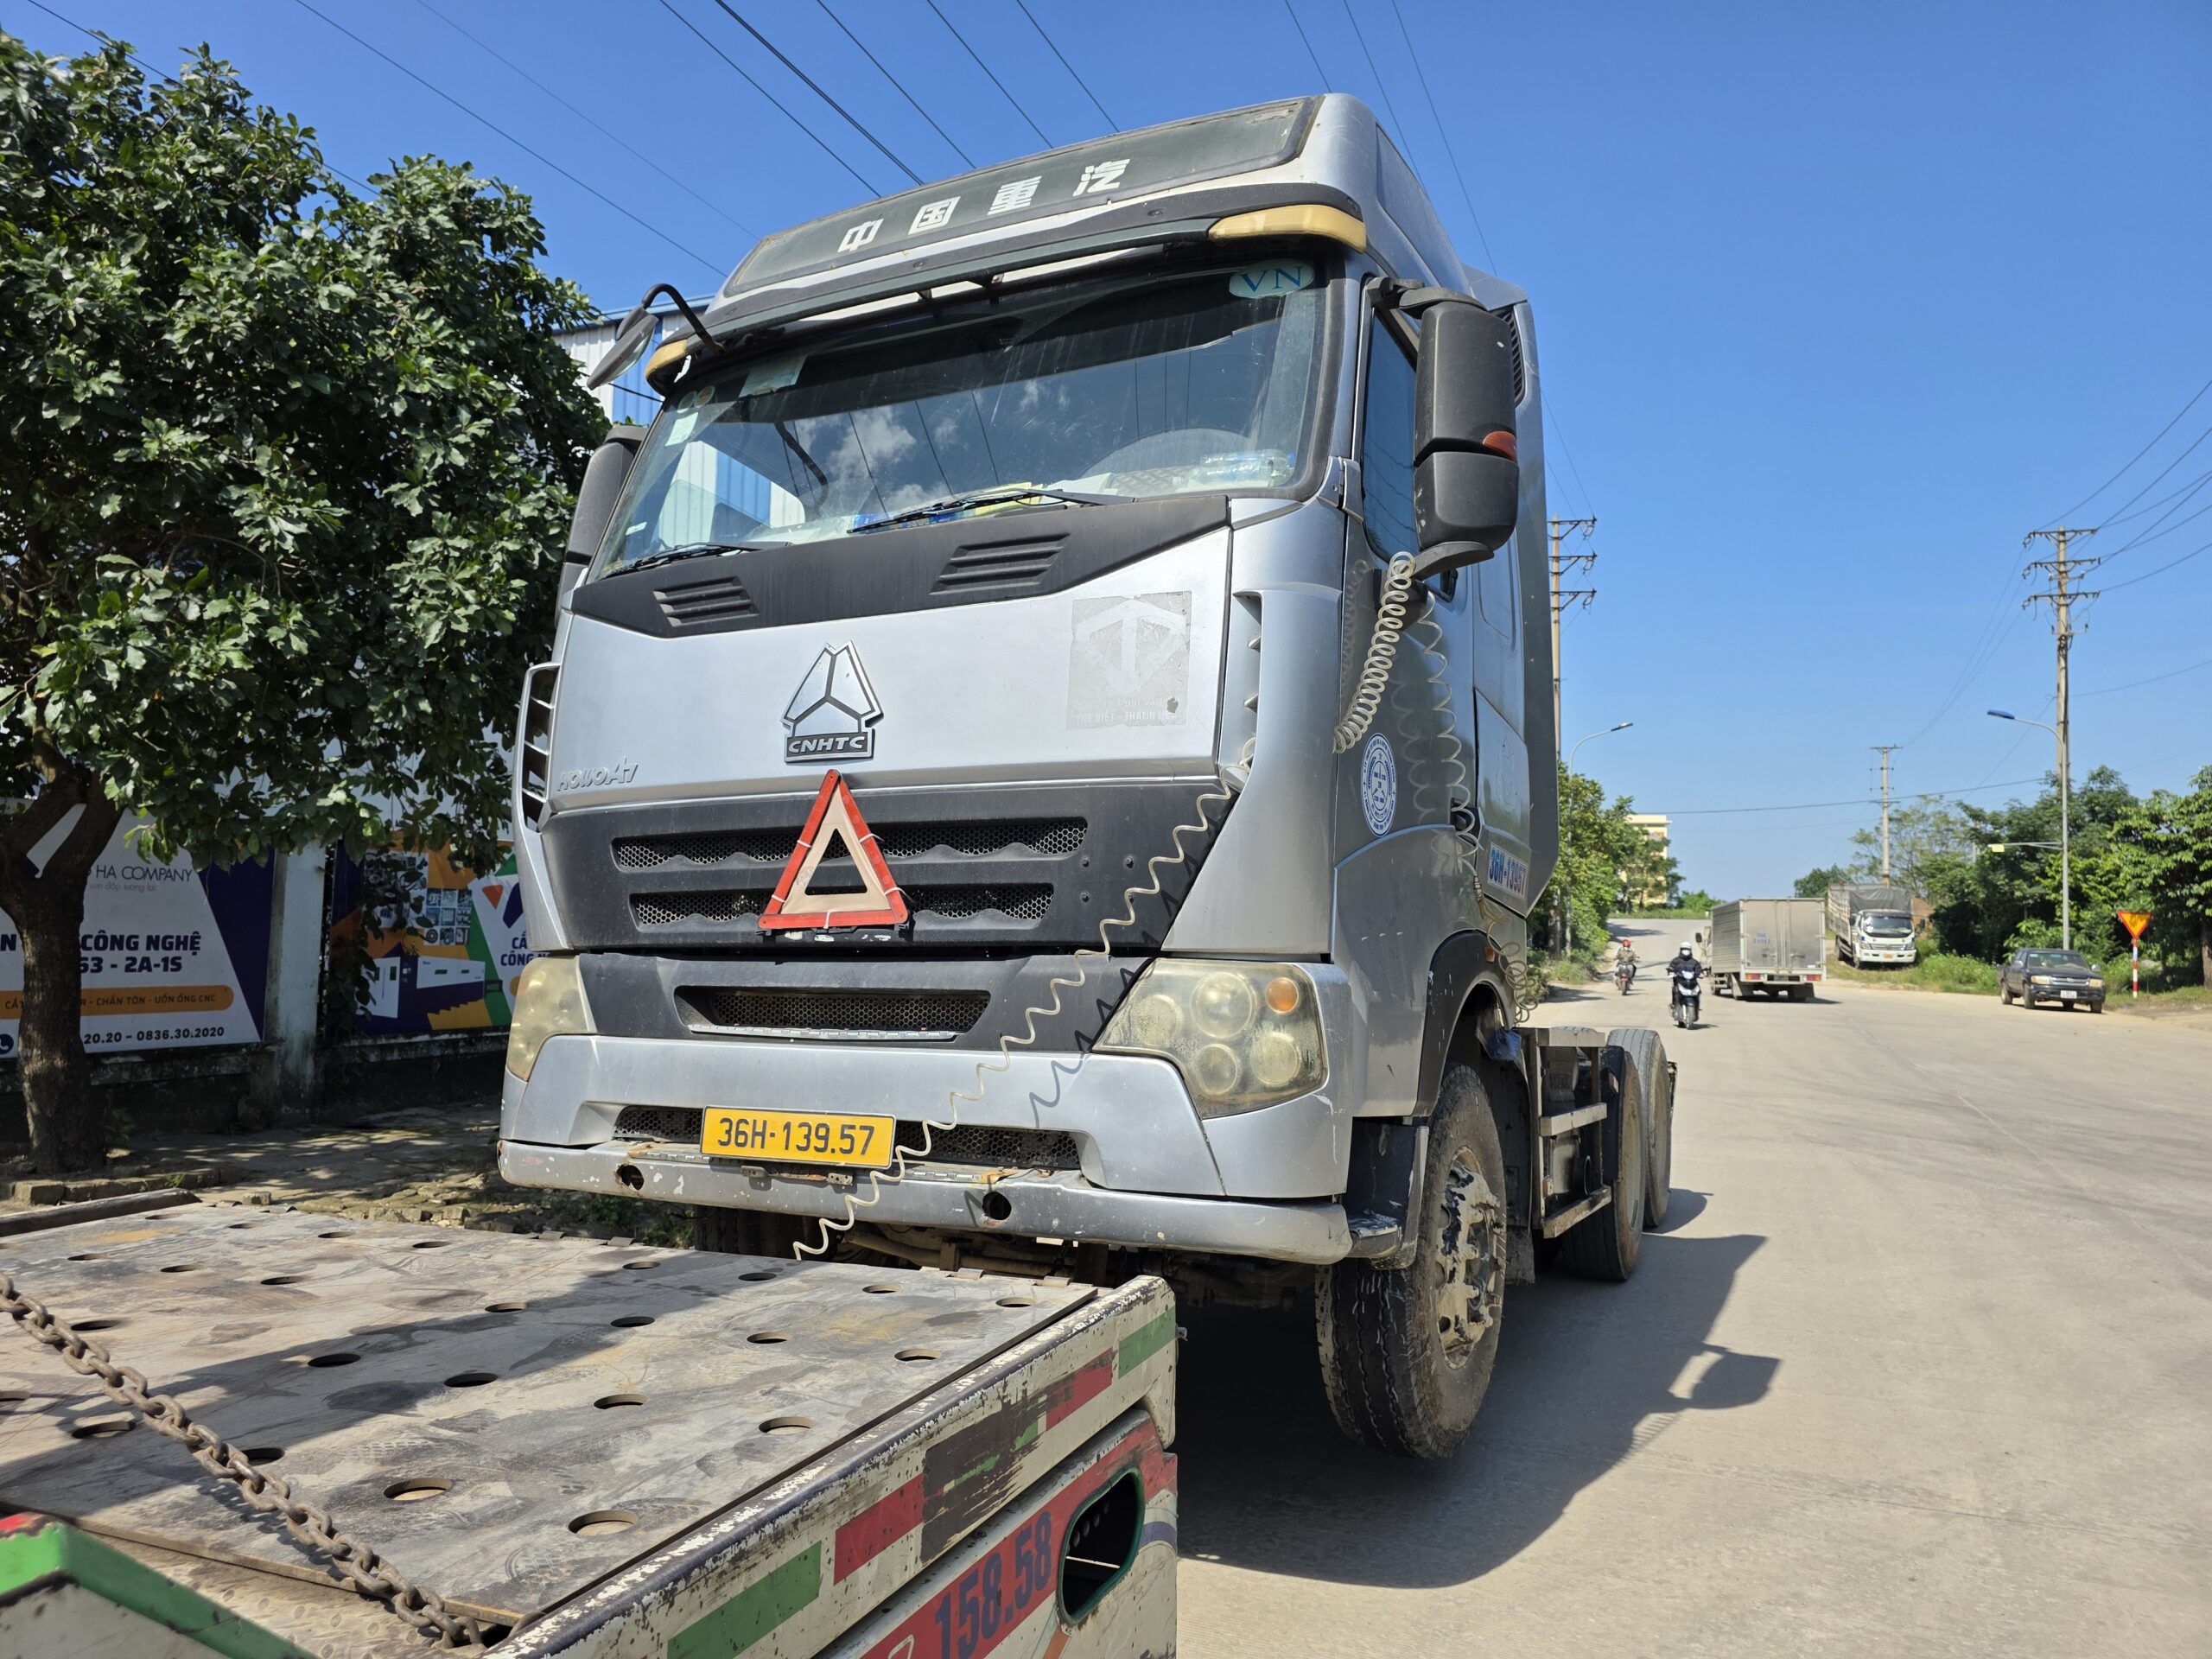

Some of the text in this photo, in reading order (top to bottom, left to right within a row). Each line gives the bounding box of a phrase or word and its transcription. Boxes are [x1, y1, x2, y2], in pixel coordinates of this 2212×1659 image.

[837, 159, 1130, 253] 中国重汽
[1238, 266, 1303, 292] VN
[788, 736, 865, 753] CNHTC
[122, 865, 193, 882] COMPANY
[80, 930, 139, 952] CÔNG
[145, 931, 201, 956] NGHỆ
[124, 957, 182, 973] 2A-1S
[199, 994, 216, 1002] CNC
[137, 1027, 225, 1041] 0836.30.2020
[718, 1117, 874, 1155] 36H-139.57
[935, 1510, 1052, 1659] 158.58
